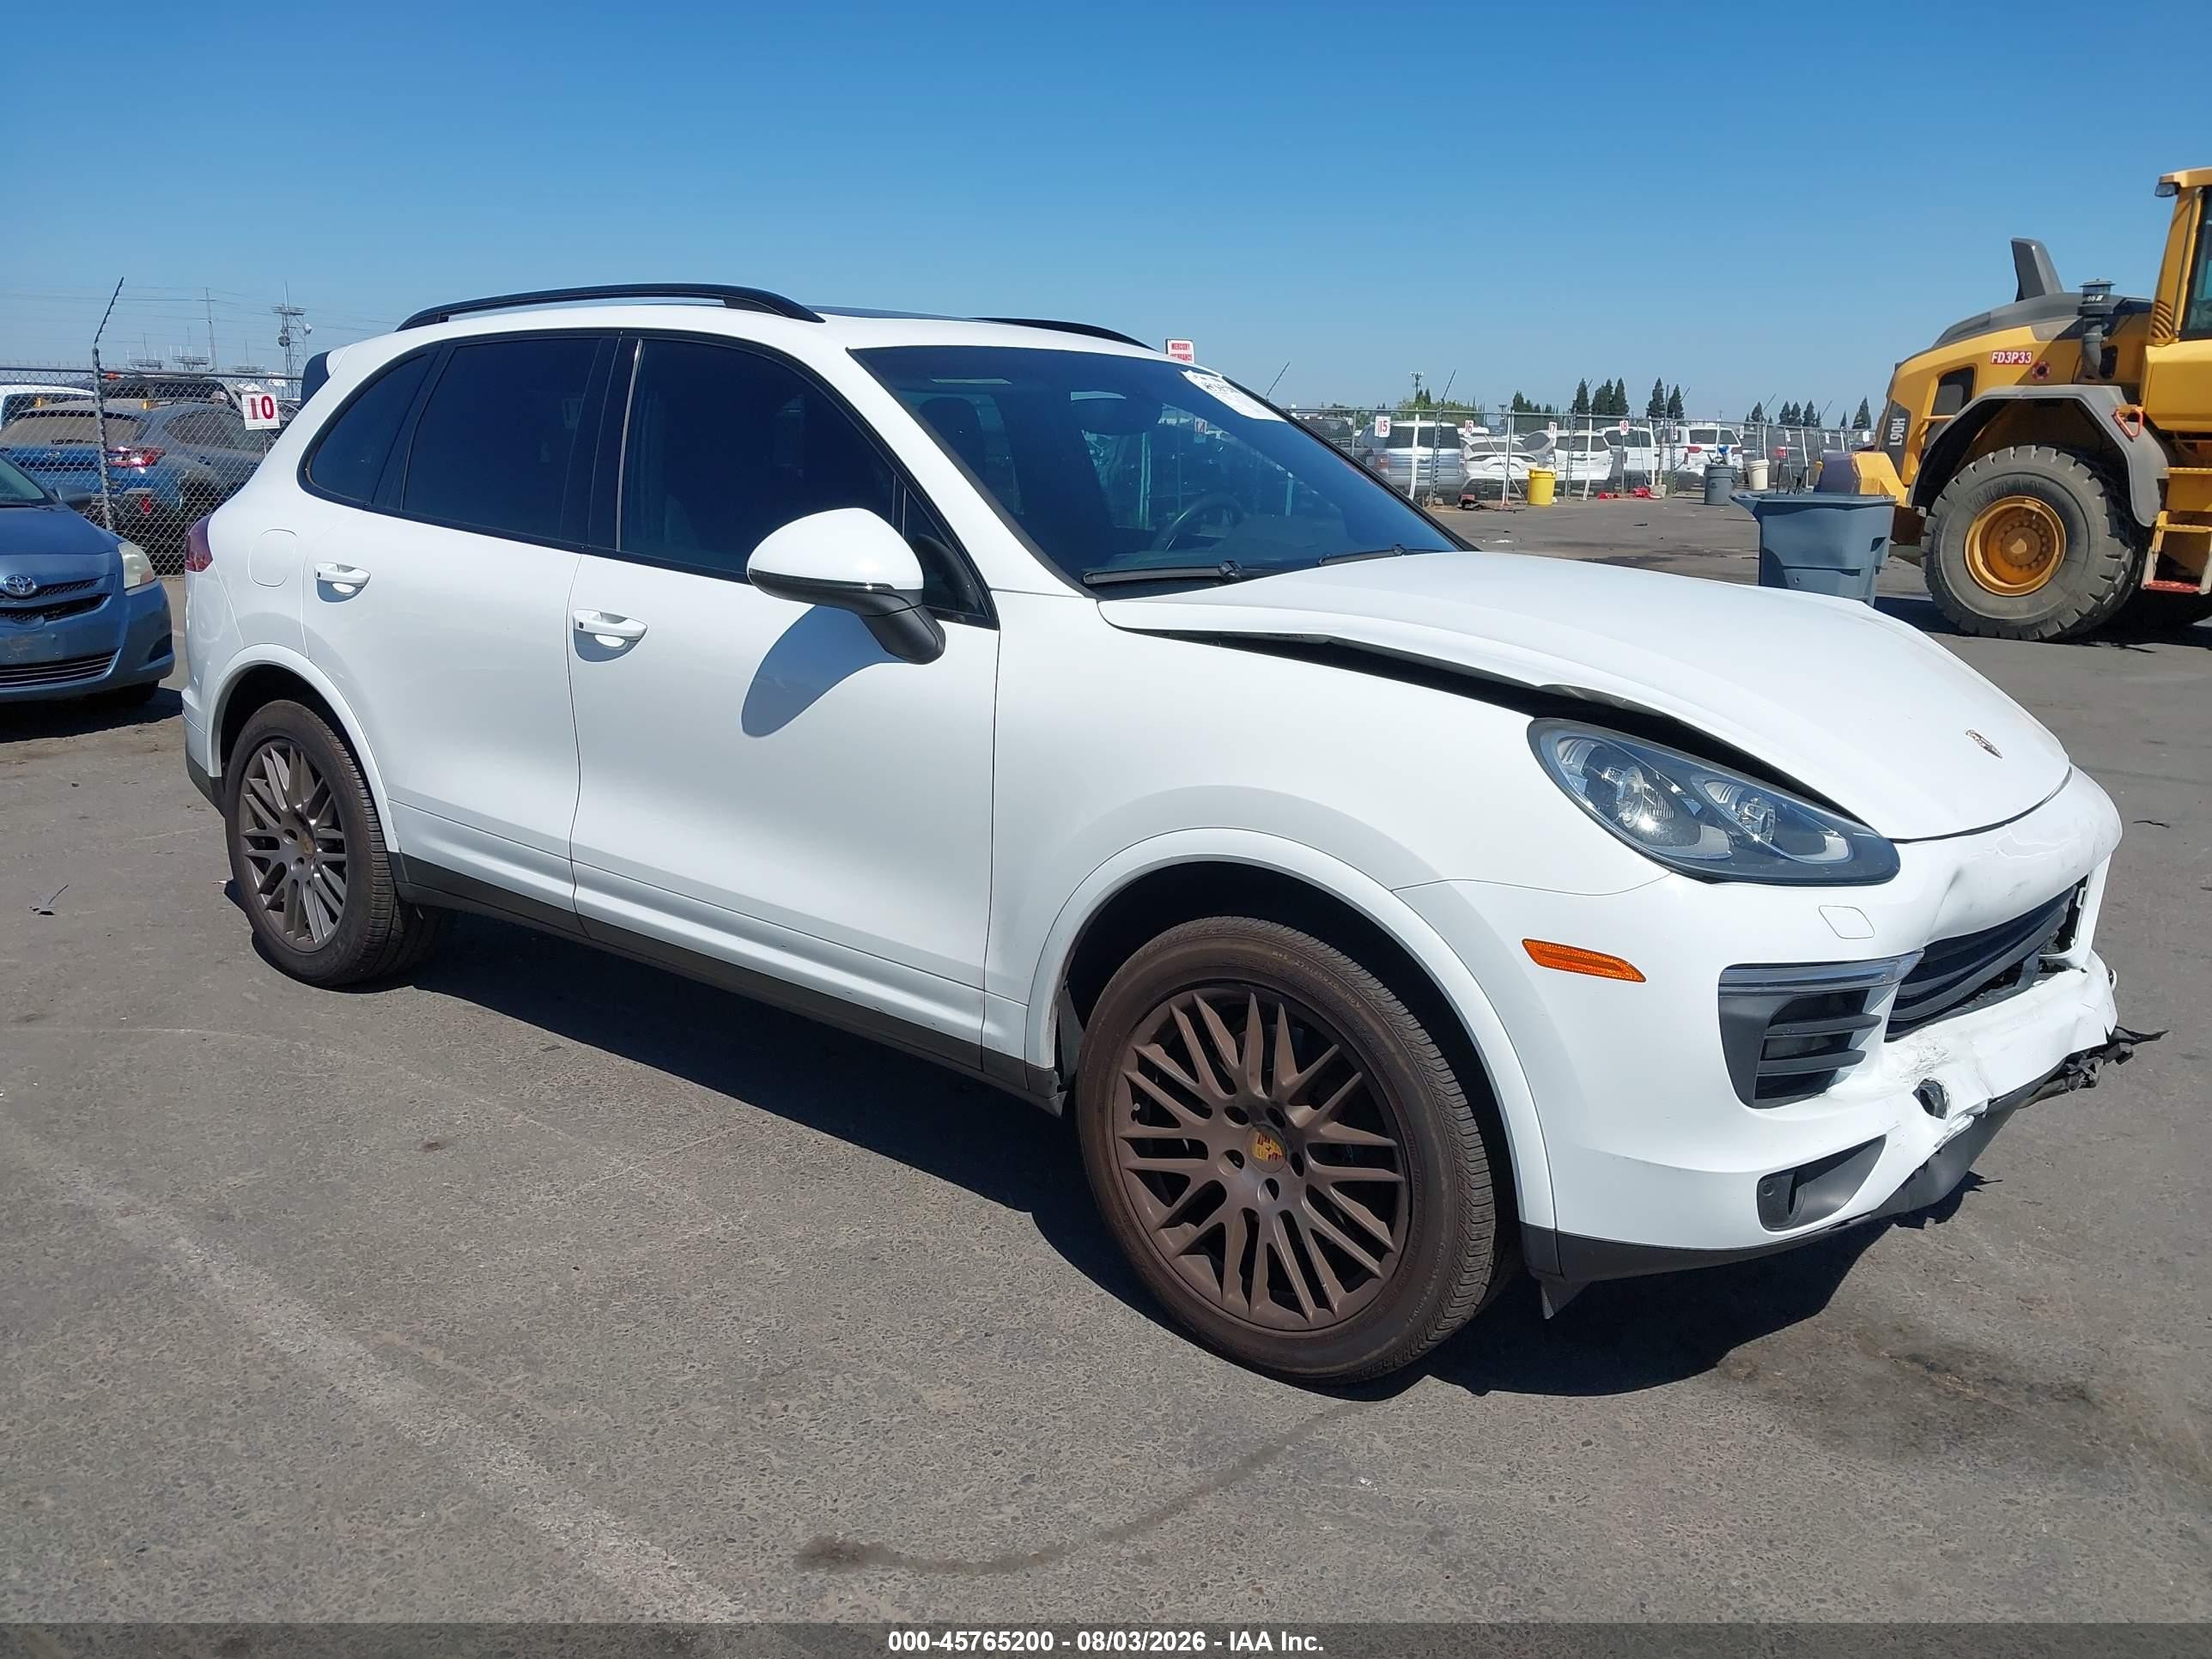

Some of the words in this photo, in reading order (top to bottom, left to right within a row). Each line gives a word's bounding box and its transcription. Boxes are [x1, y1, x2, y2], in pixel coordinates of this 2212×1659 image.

[1991, 352, 2032, 363] FD3P33
[250, 396, 274, 420] 10
[1380, 420, 1388, 433] 15
[1465, 421, 1472, 433] 16
[1549, 423, 1556, 434] 17
[1620, 421, 1627, 432] 18
[1889, 417, 1906, 446] L90H
